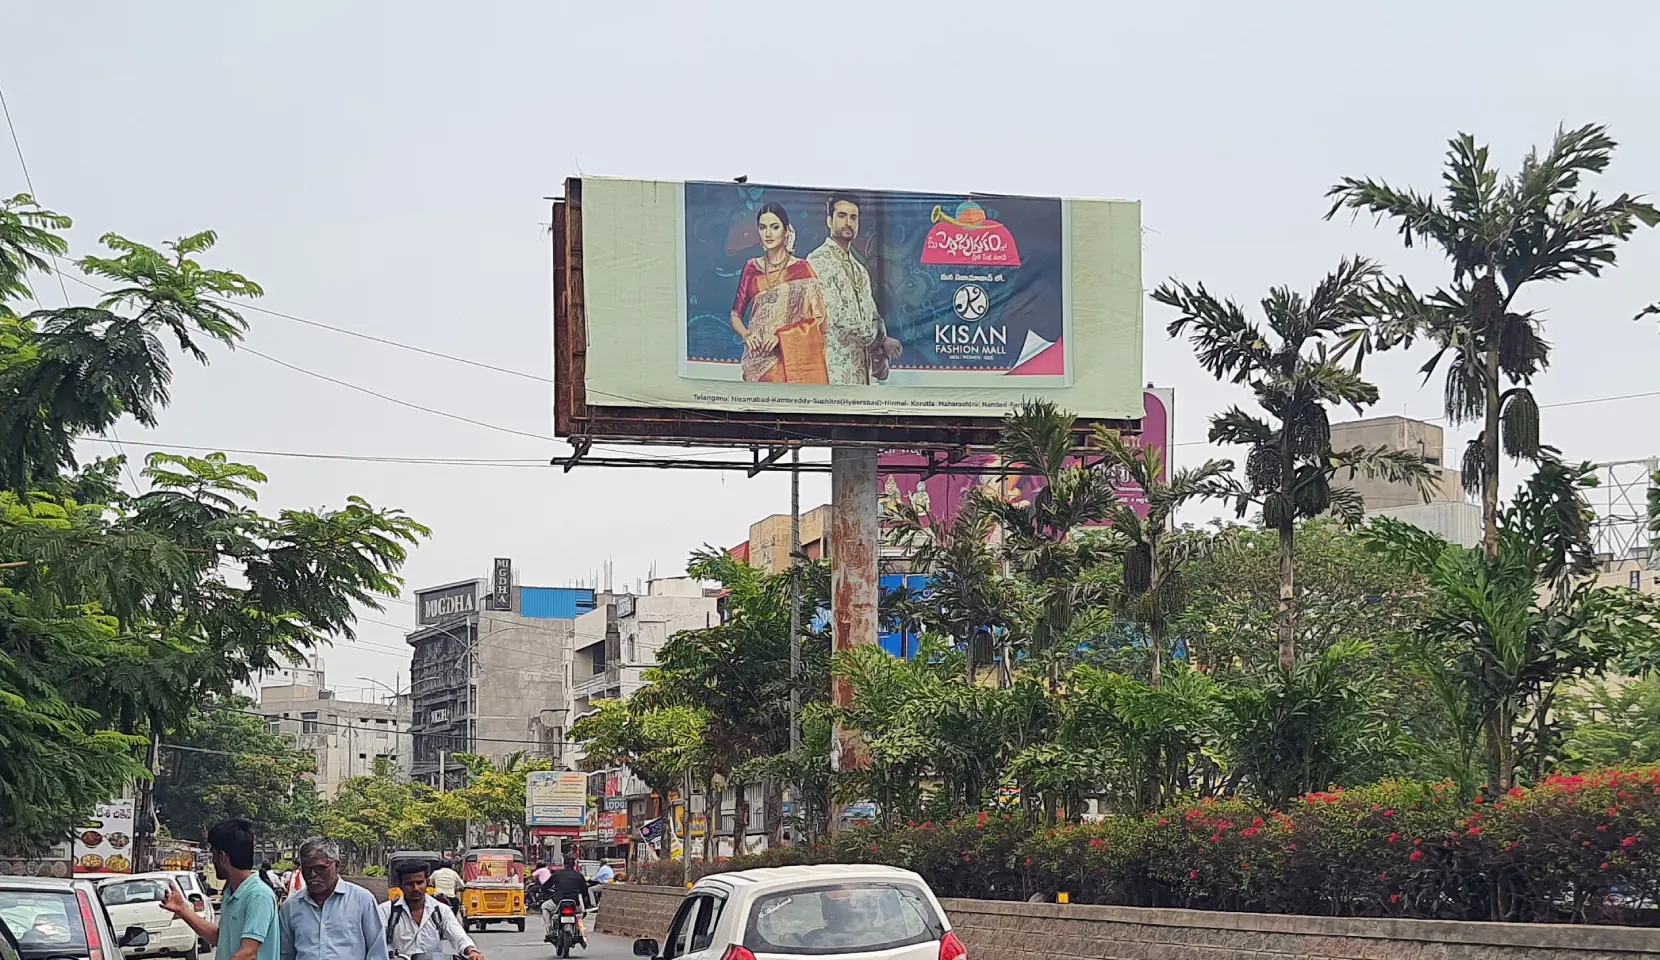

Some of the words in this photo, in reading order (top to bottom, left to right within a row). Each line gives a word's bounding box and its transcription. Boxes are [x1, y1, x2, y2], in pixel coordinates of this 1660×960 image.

[935, 324, 1007, 345] KISAN
[935, 344, 979, 354] FASHION
[981, 346, 1007, 355] MALL
